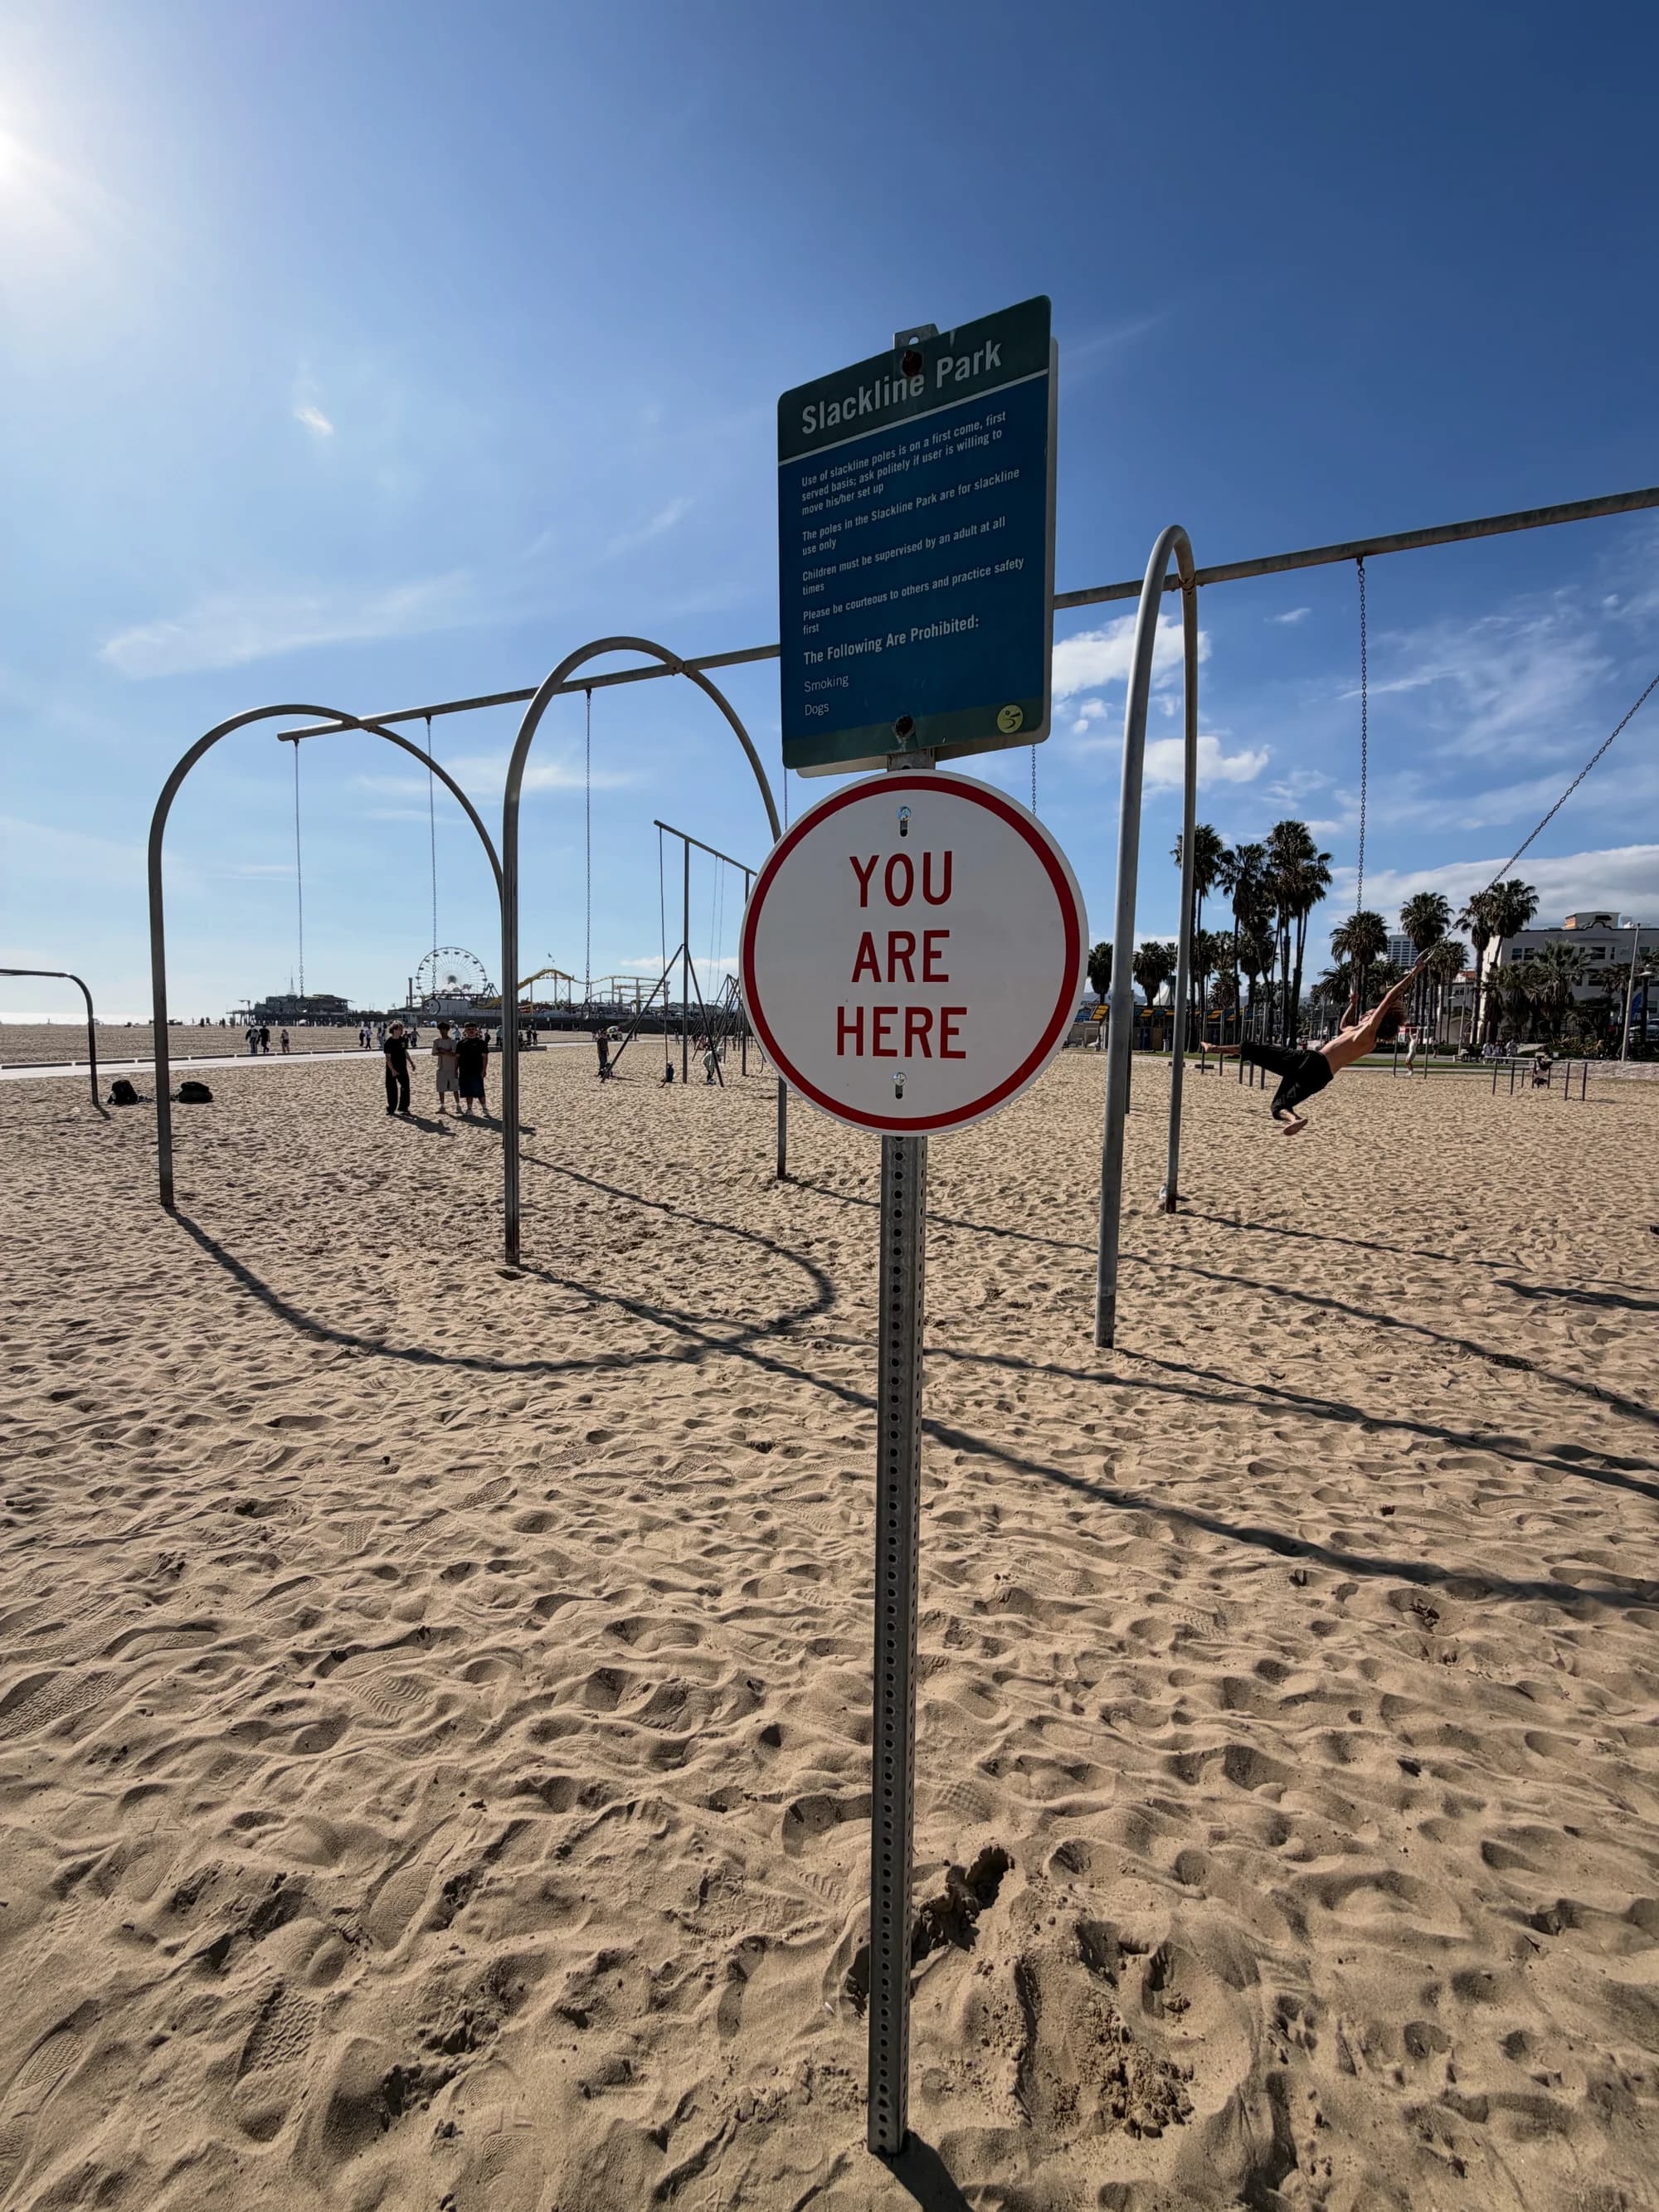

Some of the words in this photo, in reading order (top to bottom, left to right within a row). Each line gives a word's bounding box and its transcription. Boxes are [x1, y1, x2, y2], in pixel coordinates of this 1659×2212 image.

[801, 375, 925, 435] Slackline
[936, 340, 1003, 389] Park
[801, 474, 817, 487] Use
[820, 471, 828, 482] of
[830, 457, 869, 477] slackline
[872, 449, 896, 467] poles
[898, 445, 907, 456] is
[909, 440, 921, 452] on
[923, 437, 930, 448] a
[932, 428, 951, 445] first
[953, 421, 983, 438] come,
[985, 411, 1006, 427] first
[801, 484, 829, 501] served
[831, 477, 857, 493] basis;
[859, 470, 875, 484] ask
[877, 458, 911, 479] politely
[912, 453, 920, 465] if
[922, 448, 943, 464] user
[945, 444, 954, 455] is
[956, 432, 990, 452] willing
[992, 428, 1003, 440] to
[801, 503, 824, 516] move
[825, 491, 854, 509] his/her
[857, 488, 870, 499] set
[873, 483, 883, 495] up
[802, 530, 818, 542] The
[820, 523, 843, 539] poles
[844, 518, 854, 530] in
[855, 513, 869, 525] the
[871, 502, 914, 522] Slackline
[916, 493, 938, 509] Park
[940, 488, 956, 502] are
[958, 483, 971, 496] for
[974, 468, 1020, 491] slackline
[802, 544, 817, 557] use
[819, 538, 837, 551] only
[802, 565, 837, 581] Children
[839, 557, 860, 571] must
[862, 554, 873, 566] be
[874, 540, 923, 563] supervised
[925, 536, 937, 550] by
[938, 533, 951, 545] an
[953, 524, 978, 541] adult
[980, 520, 990, 532] at
[992, 516, 1006, 529] all
[802, 582, 825, 596] times
[803, 606, 830, 622] Please
[832, 603, 844, 615] be
[845, 592, 888, 611] courteous
[889, 589, 899, 600] to
[901, 581, 930, 597] others
[932, 575, 950, 591] and
[951, 566, 992, 587] practice
[994, 557, 1024, 574] safety
[803, 623, 820, 635] first
[804, 650, 824, 665] The
[827, 637, 883, 661] Following
[886, 632, 907, 649] Are
[910, 613, 980, 643] Prohibited:
[805, 675, 849, 693] Smoking
[805, 702, 830, 717] Dogs
[849, 850, 952, 908] YOU
[851, 930, 950, 983] ARE
[836, 1006, 967, 1059] HERE
